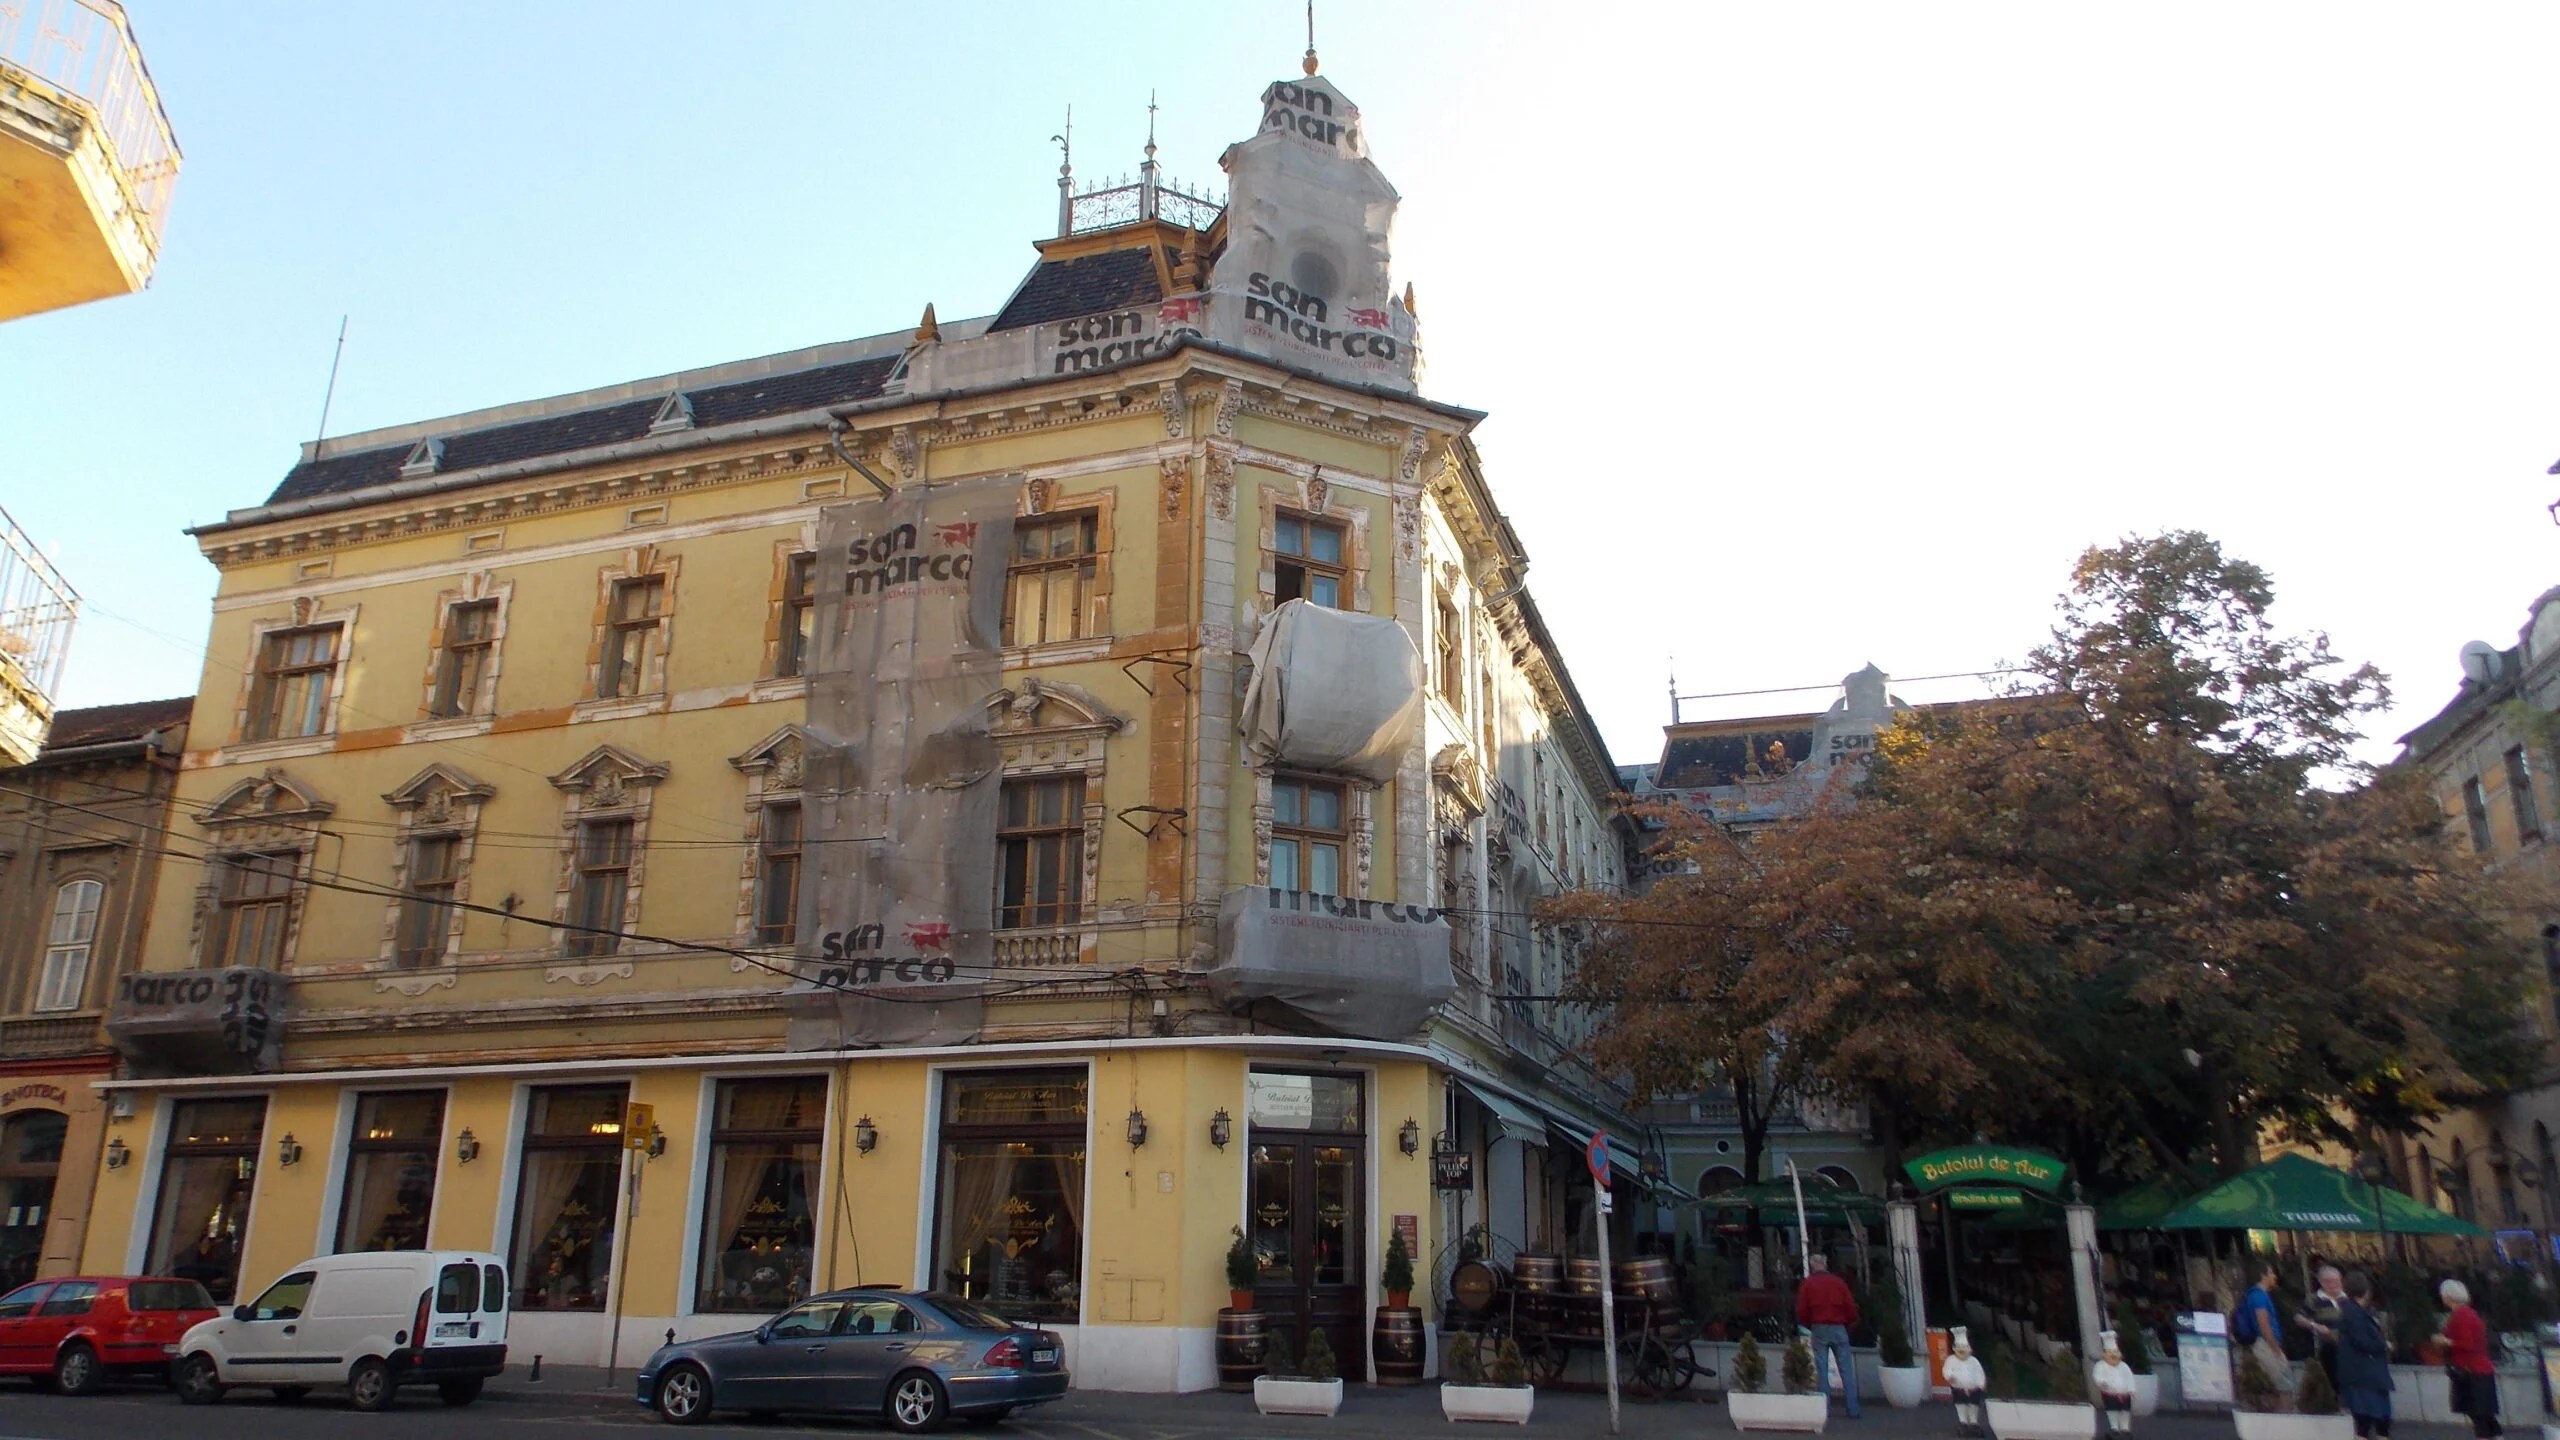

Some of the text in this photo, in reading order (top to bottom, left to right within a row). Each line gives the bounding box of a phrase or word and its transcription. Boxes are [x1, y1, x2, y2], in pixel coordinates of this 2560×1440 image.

[1248, 271, 1328, 322] san
[1058, 311, 1142, 346] san
[1244, 295, 1397, 362] marco
[848, 523, 916, 565] san
[845, 554, 973, 597] marco
[1924, 1153, 2049, 1181] Butoiul de Aur
[2282, 1212, 2361, 1224] TUBORG
